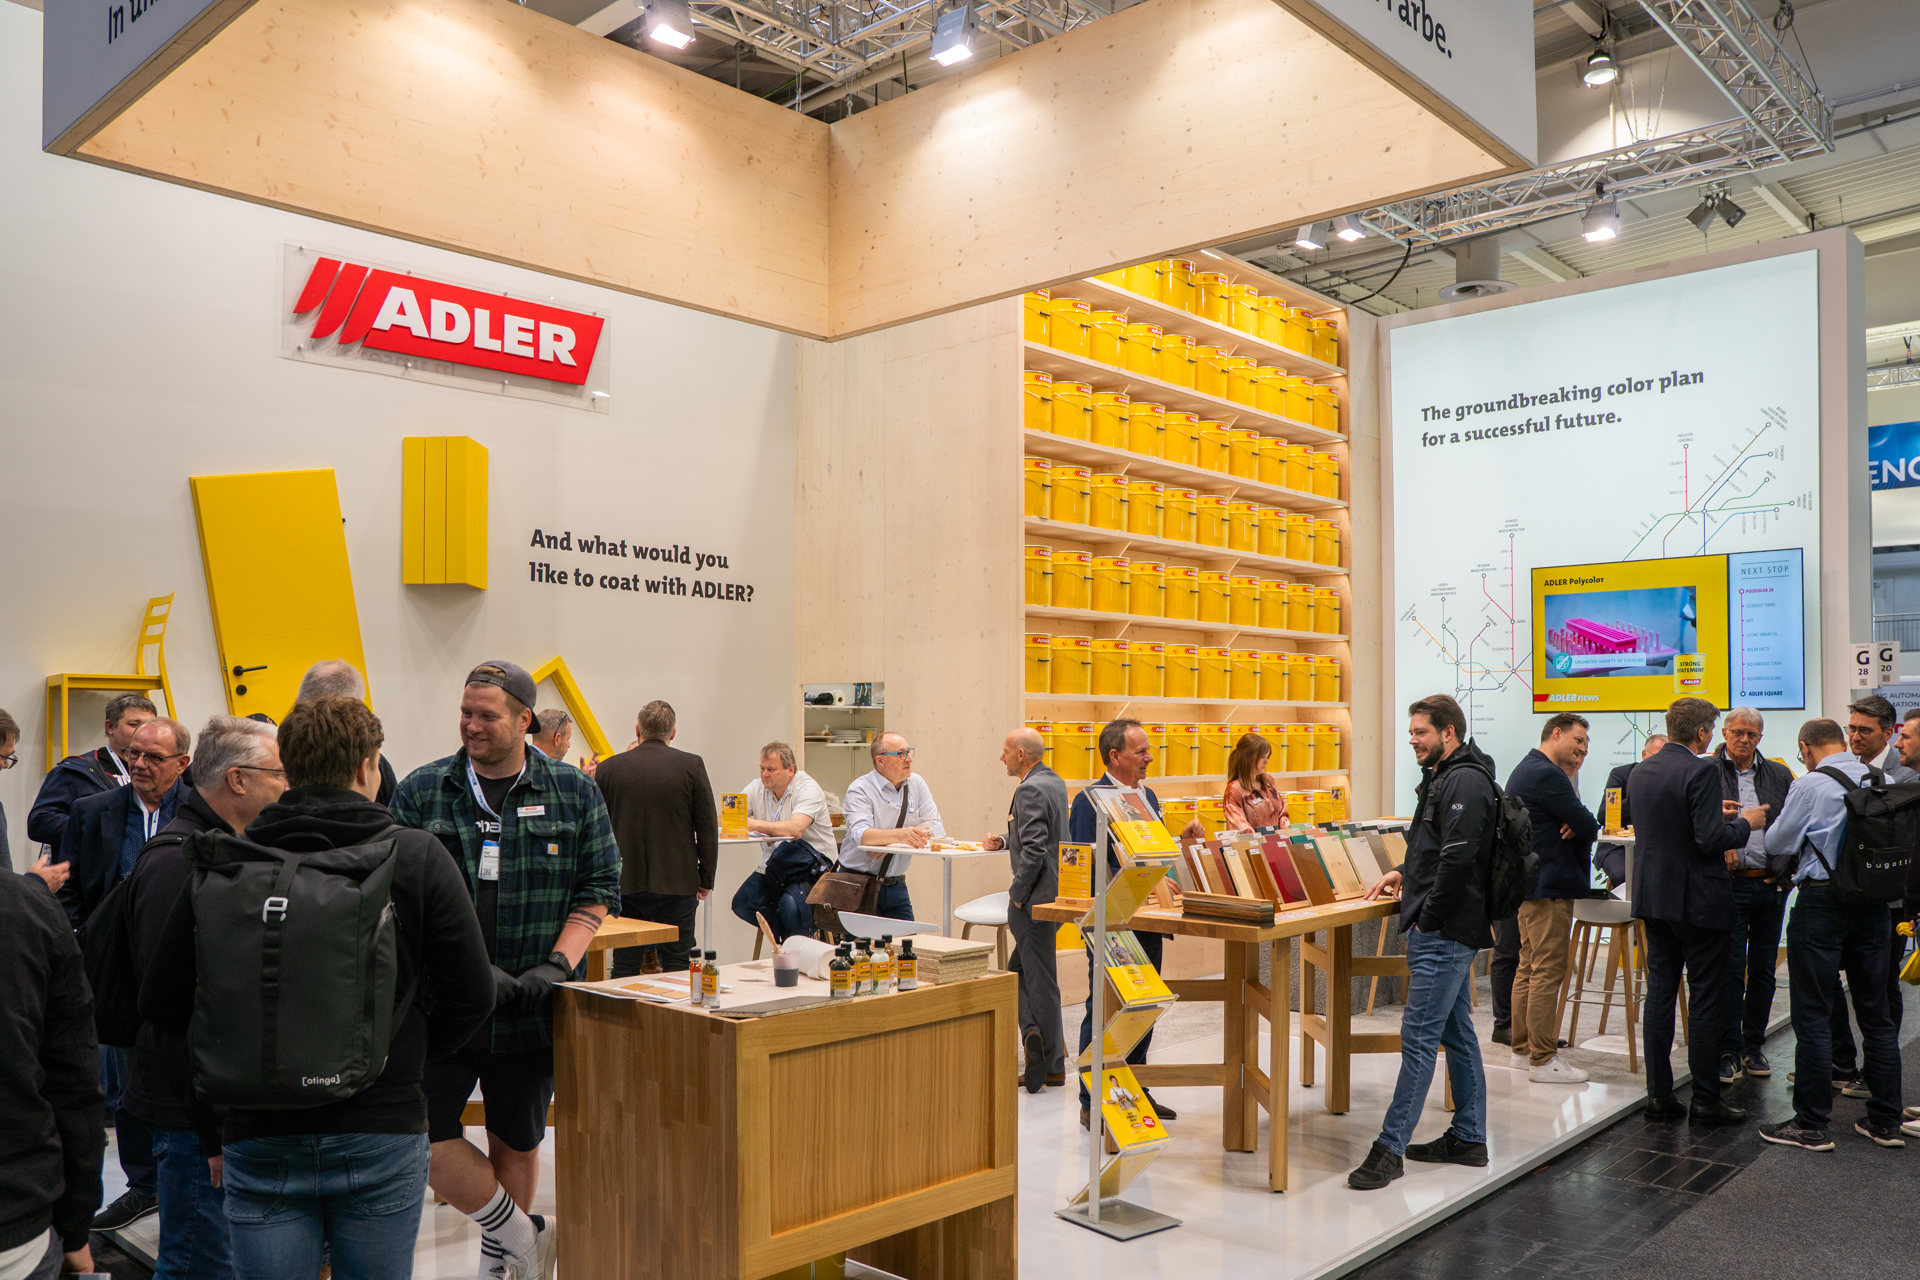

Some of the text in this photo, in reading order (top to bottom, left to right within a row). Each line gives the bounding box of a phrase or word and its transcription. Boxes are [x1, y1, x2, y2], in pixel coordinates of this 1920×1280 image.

[109, 5, 124, 45] In
[371, 285, 578, 367] ADLER
[1421, 370, 1704, 422] The groundbreaking color plan
[1422, 410, 1622, 447] for a successful future.
[530, 529, 729, 571] And what would you
[529, 562, 754, 602] like to coat with ADLER?
[1544, 576, 1604, 587] ADLER Polycolor
[1741, 565, 1789, 575] NEXT STOP
[1856, 650, 1870, 665] G
[1879, 648, 1892, 662] G
[1866, 858, 1911, 870] bugatti
